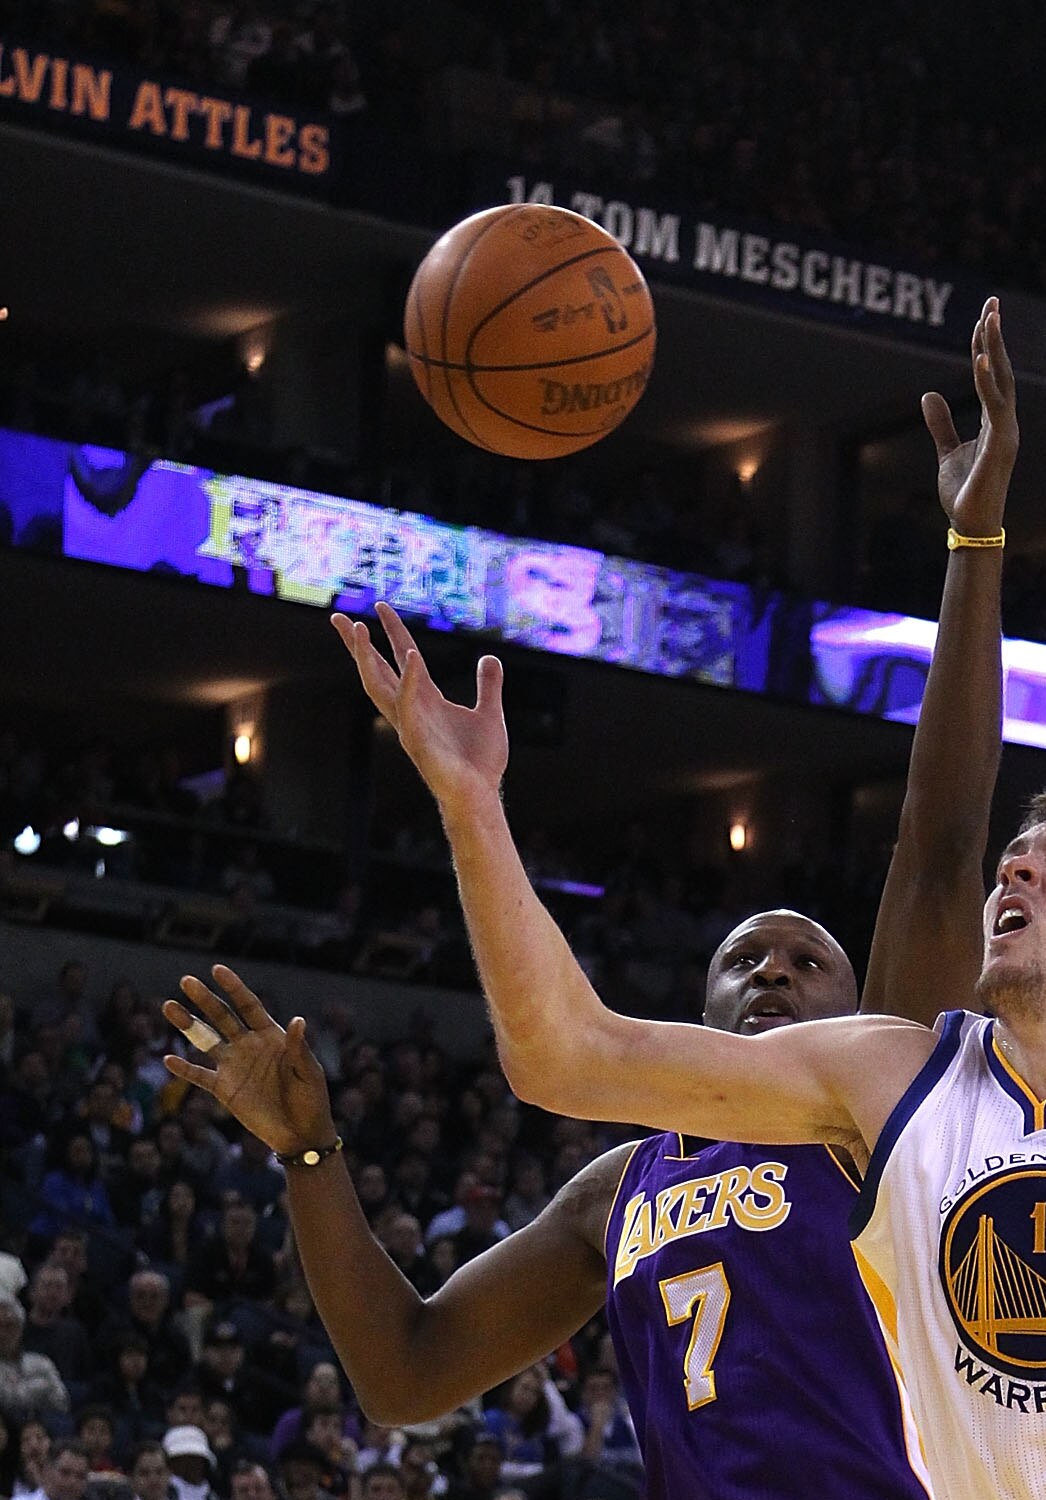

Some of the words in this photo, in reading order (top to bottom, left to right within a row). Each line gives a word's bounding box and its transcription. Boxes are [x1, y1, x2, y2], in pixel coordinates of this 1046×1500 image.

[128, 81, 330, 175] ATTLES
[572, 191, 681, 263] TOM
[693, 222, 953, 326] MESCHERY
[613, 1161, 792, 1291] LAKERS
[658, 1261, 731, 1411] 7
